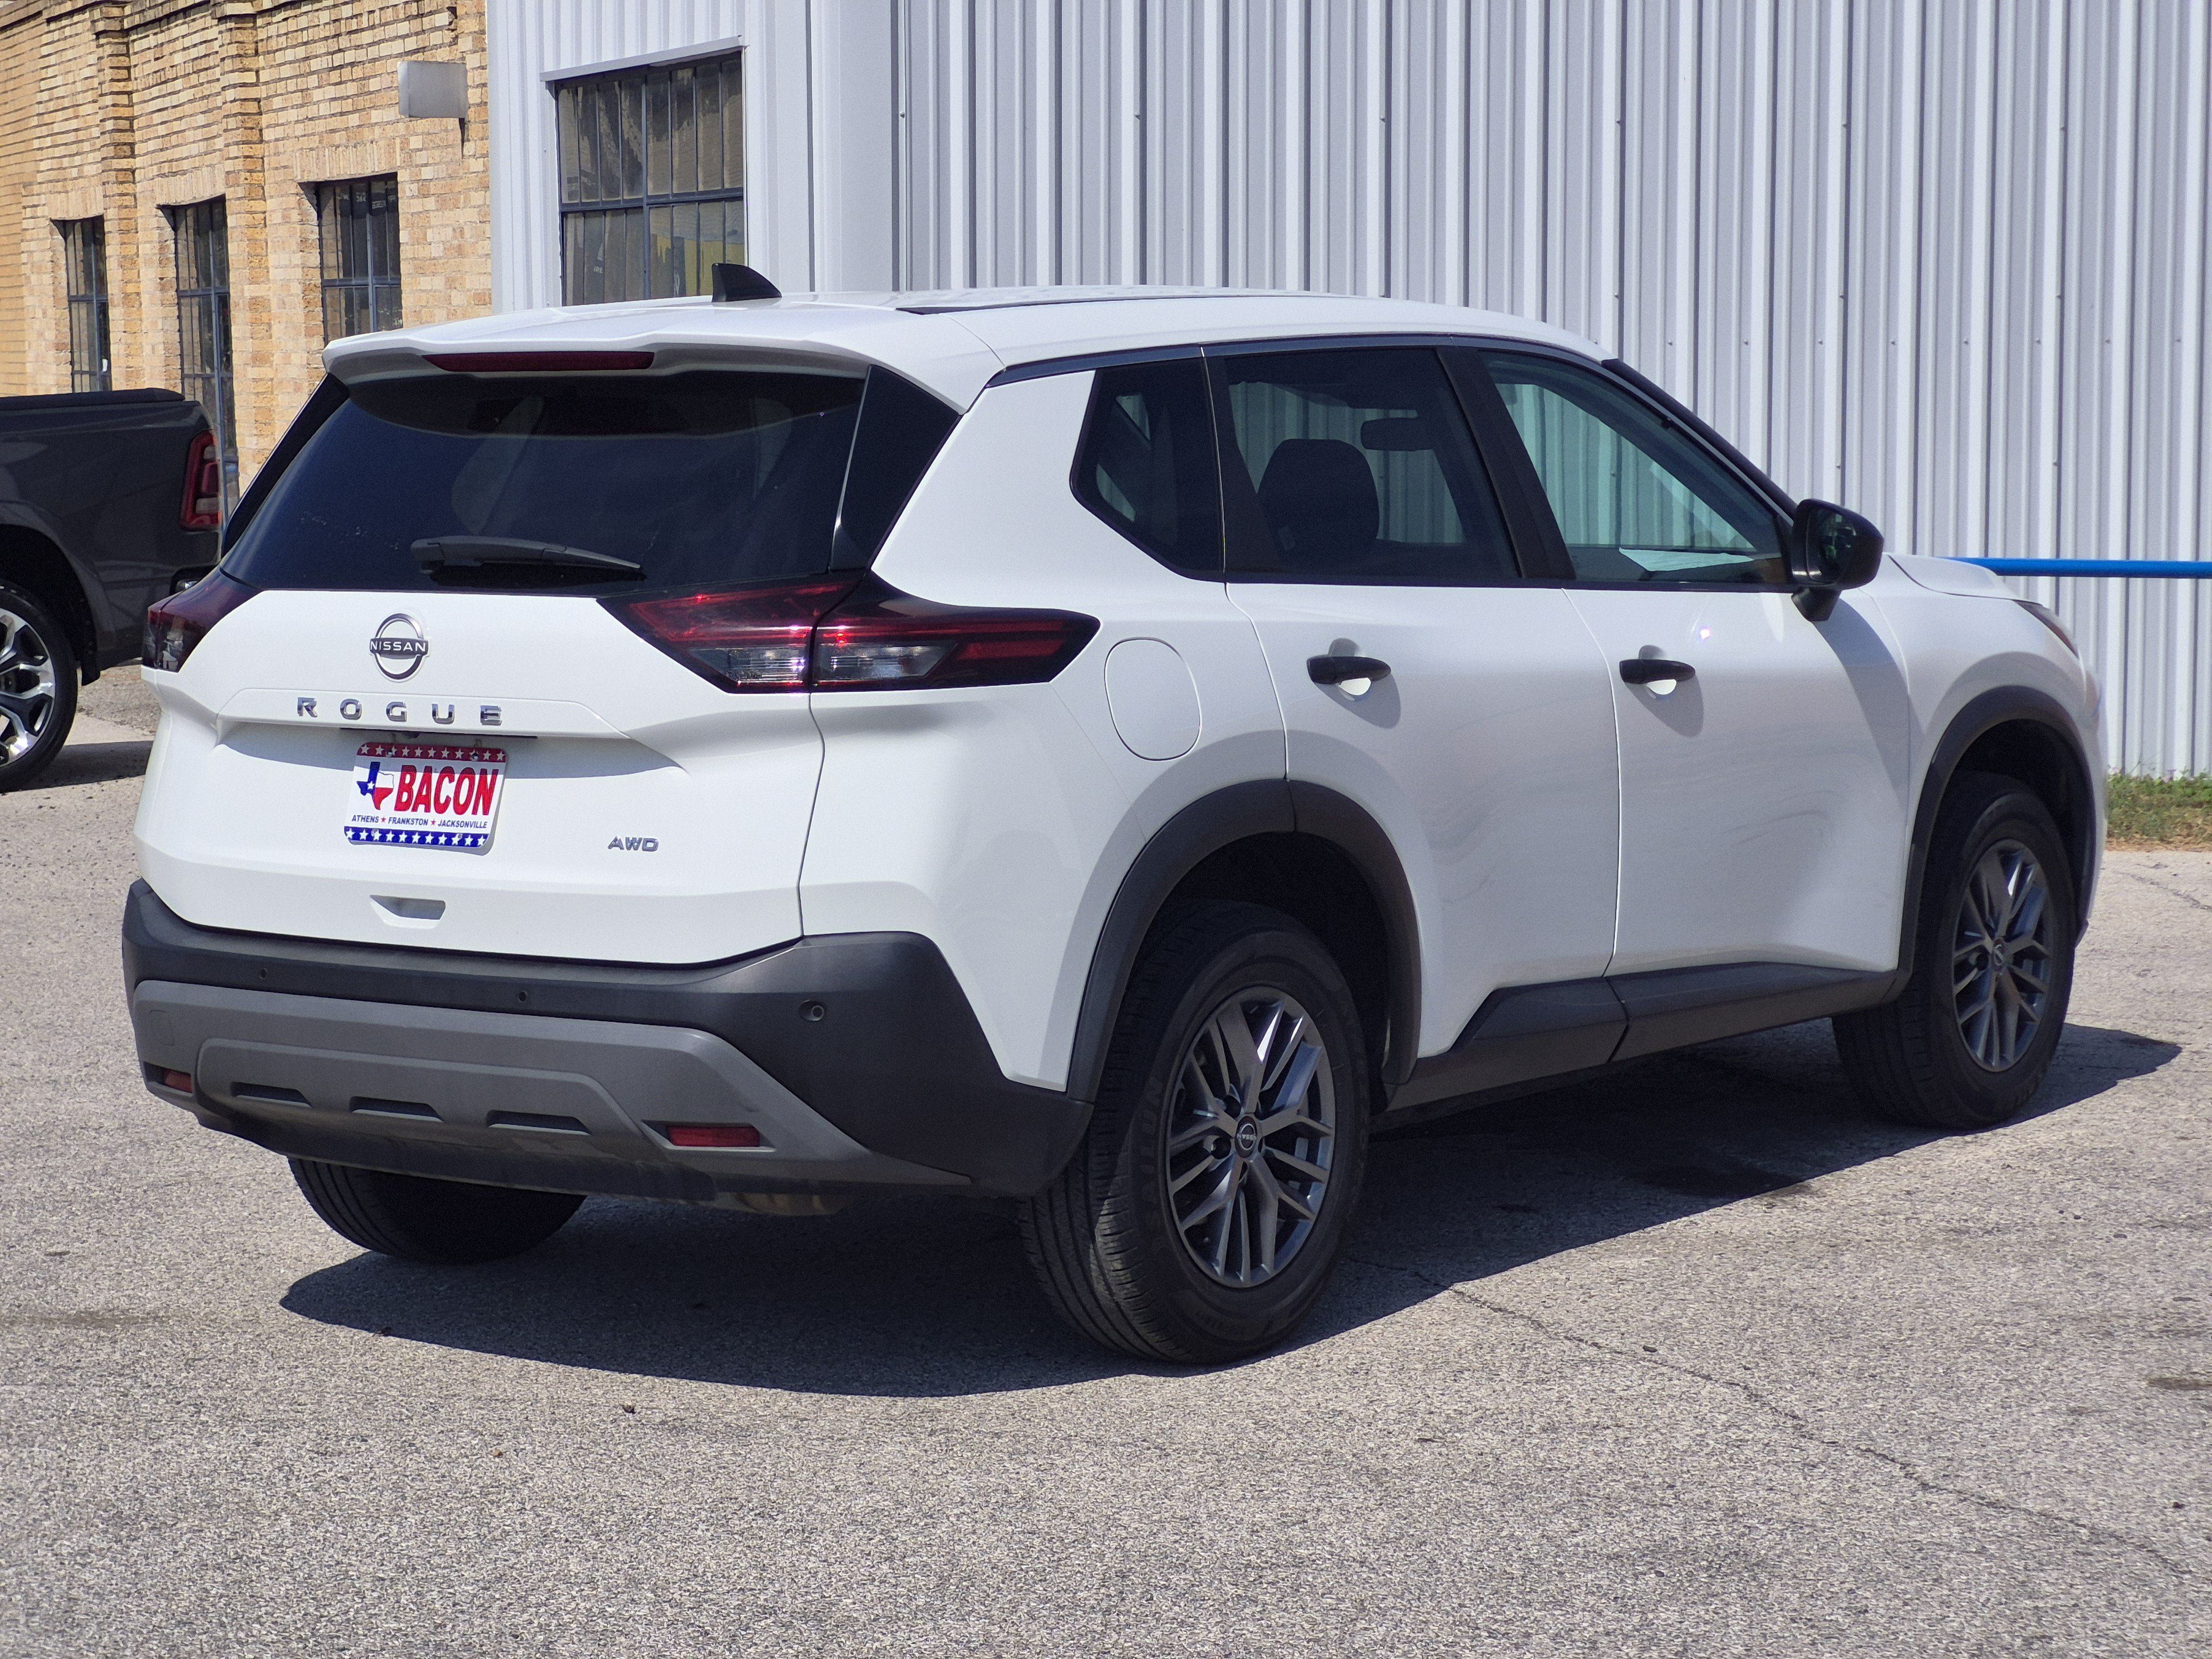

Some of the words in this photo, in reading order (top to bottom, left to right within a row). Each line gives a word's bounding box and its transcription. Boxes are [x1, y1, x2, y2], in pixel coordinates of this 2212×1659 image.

[370, 640, 426, 652] NISSAN
[297, 697, 502, 726] ROGUE
[394, 764, 499, 816] BACON
[351, 815, 379, 823] ATHENS
[388, 817, 429, 826] FRANKSTON
[437, 819, 488, 828] JACKSONVILLE
[607, 836, 659, 852] AWD
